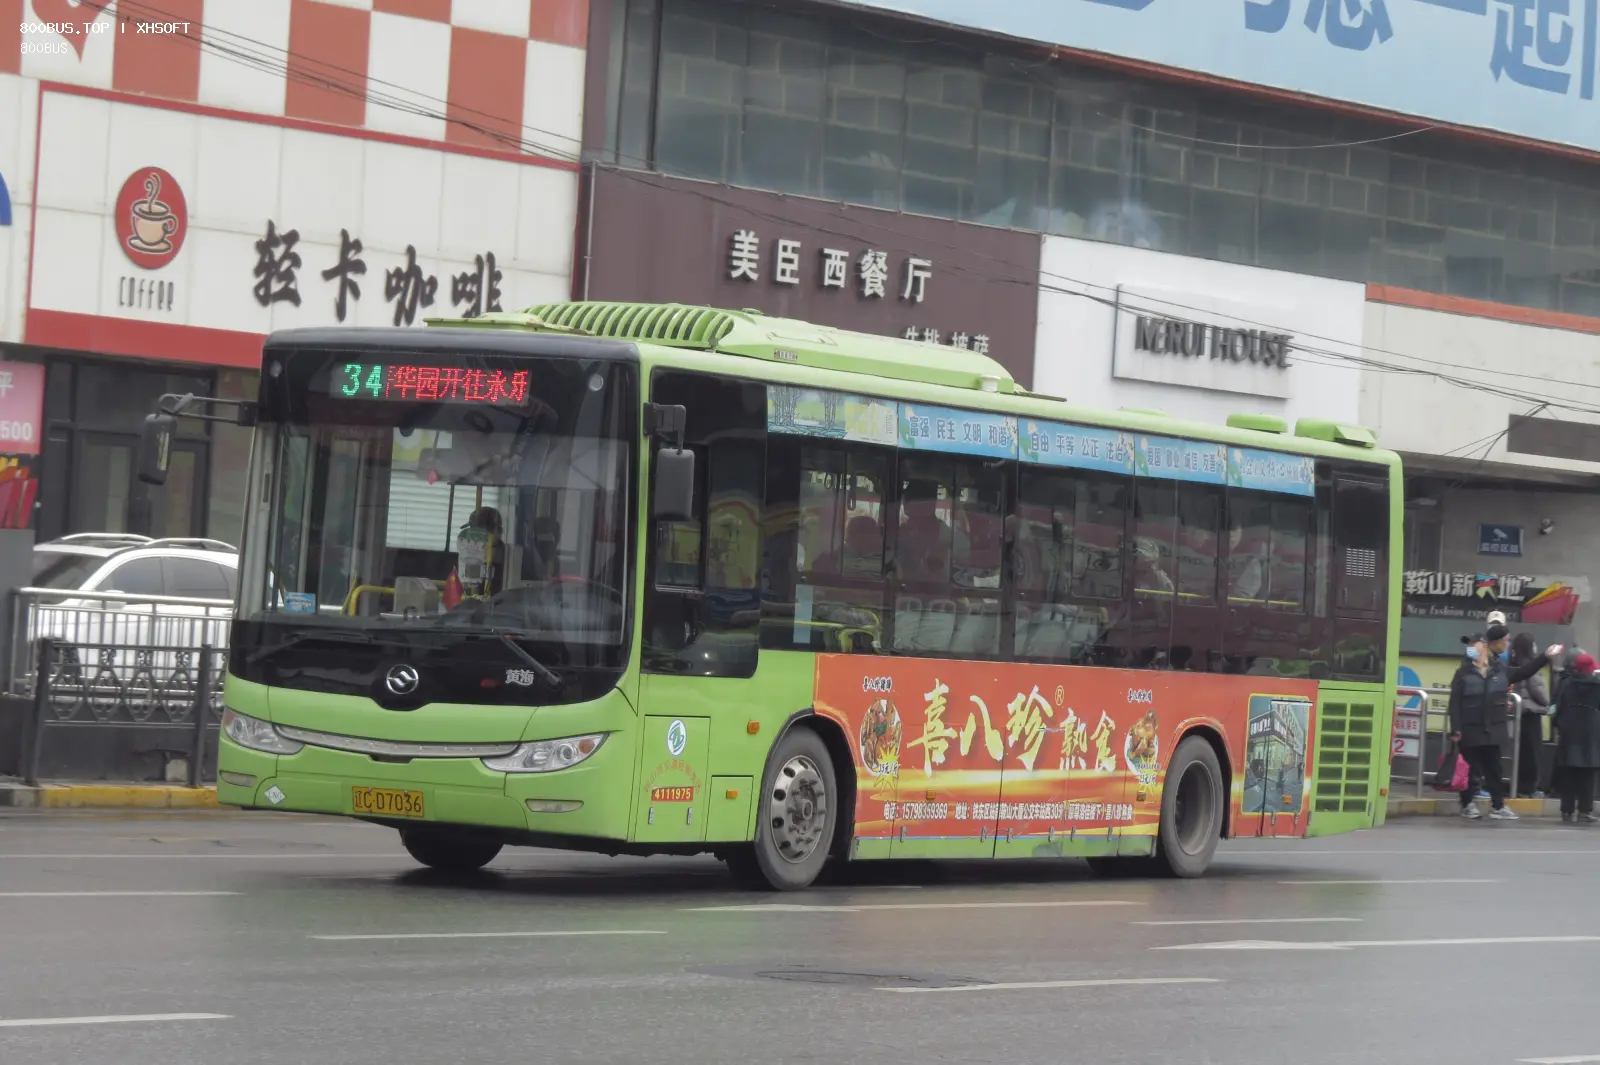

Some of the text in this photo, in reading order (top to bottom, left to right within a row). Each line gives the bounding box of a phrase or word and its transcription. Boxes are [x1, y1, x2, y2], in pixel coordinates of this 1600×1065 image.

[730, 229, 933, 303] 美臣西餐厅
[1210, 325, 1294, 369] HOUSE
[342, 364, 383, 397] 34
[910, 416, 930, 438] 富强
[936, 420, 956, 441] 民主
[963, 422, 982, 443] 文明
[988, 424, 1008, 447] 和谐
[1031, 432, 1125, 462] 自由 平等 公正 法治
[505, 669, 535, 686] 黄海
[654, 787, 691, 800] 4111975
